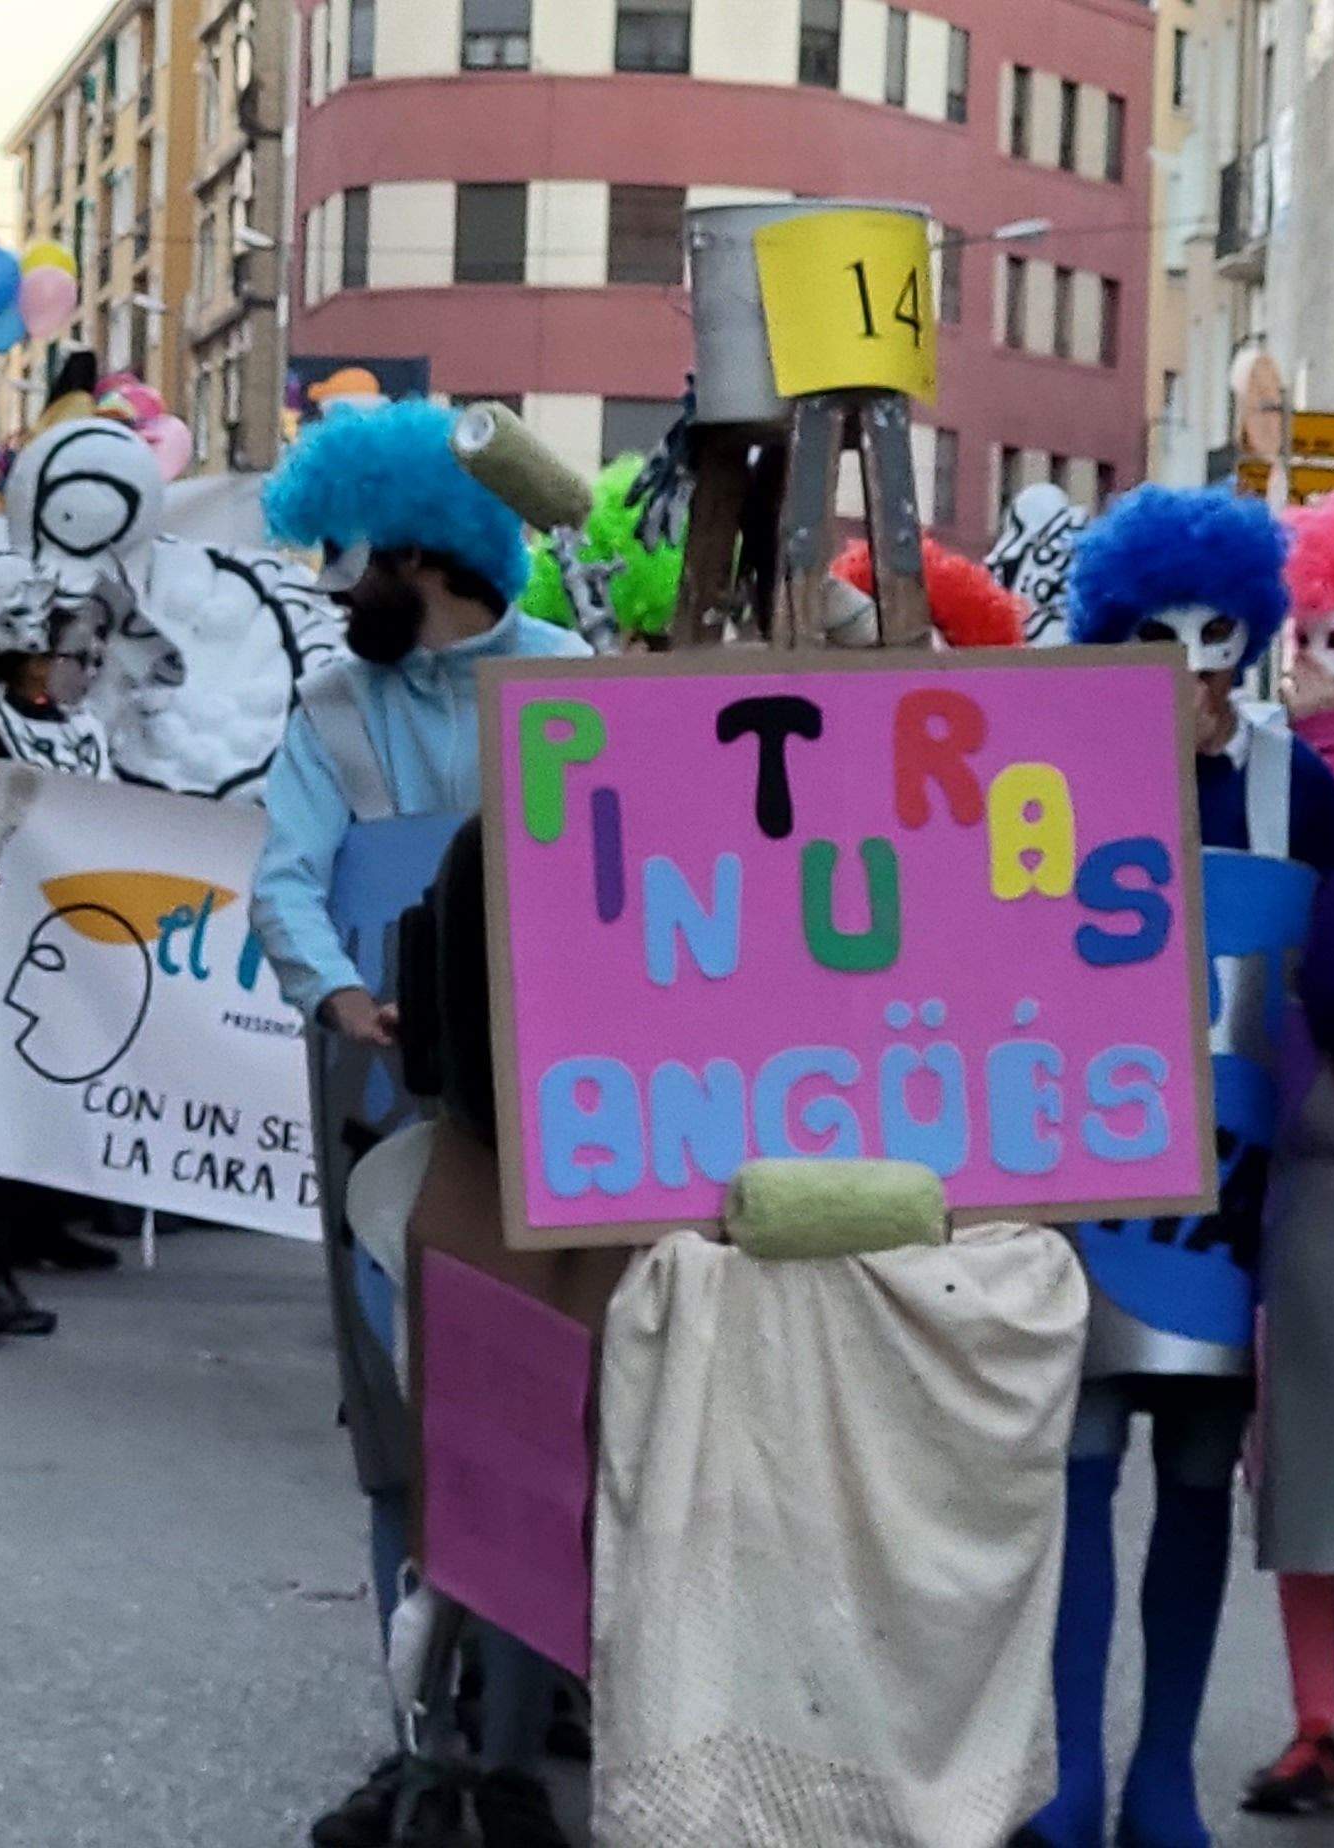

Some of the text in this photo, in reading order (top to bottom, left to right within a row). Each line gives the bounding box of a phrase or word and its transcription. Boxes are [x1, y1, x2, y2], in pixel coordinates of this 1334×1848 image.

[844, 256, 922, 350] 14
[158, 886, 215, 981] el
[83, 1082, 312, 1157] CON UN SE
[537, 998, 1170, 1198] ANGÜÉS
[103, 1132, 150, 1175] LA
[172, 1149, 275, 1200] CARA
